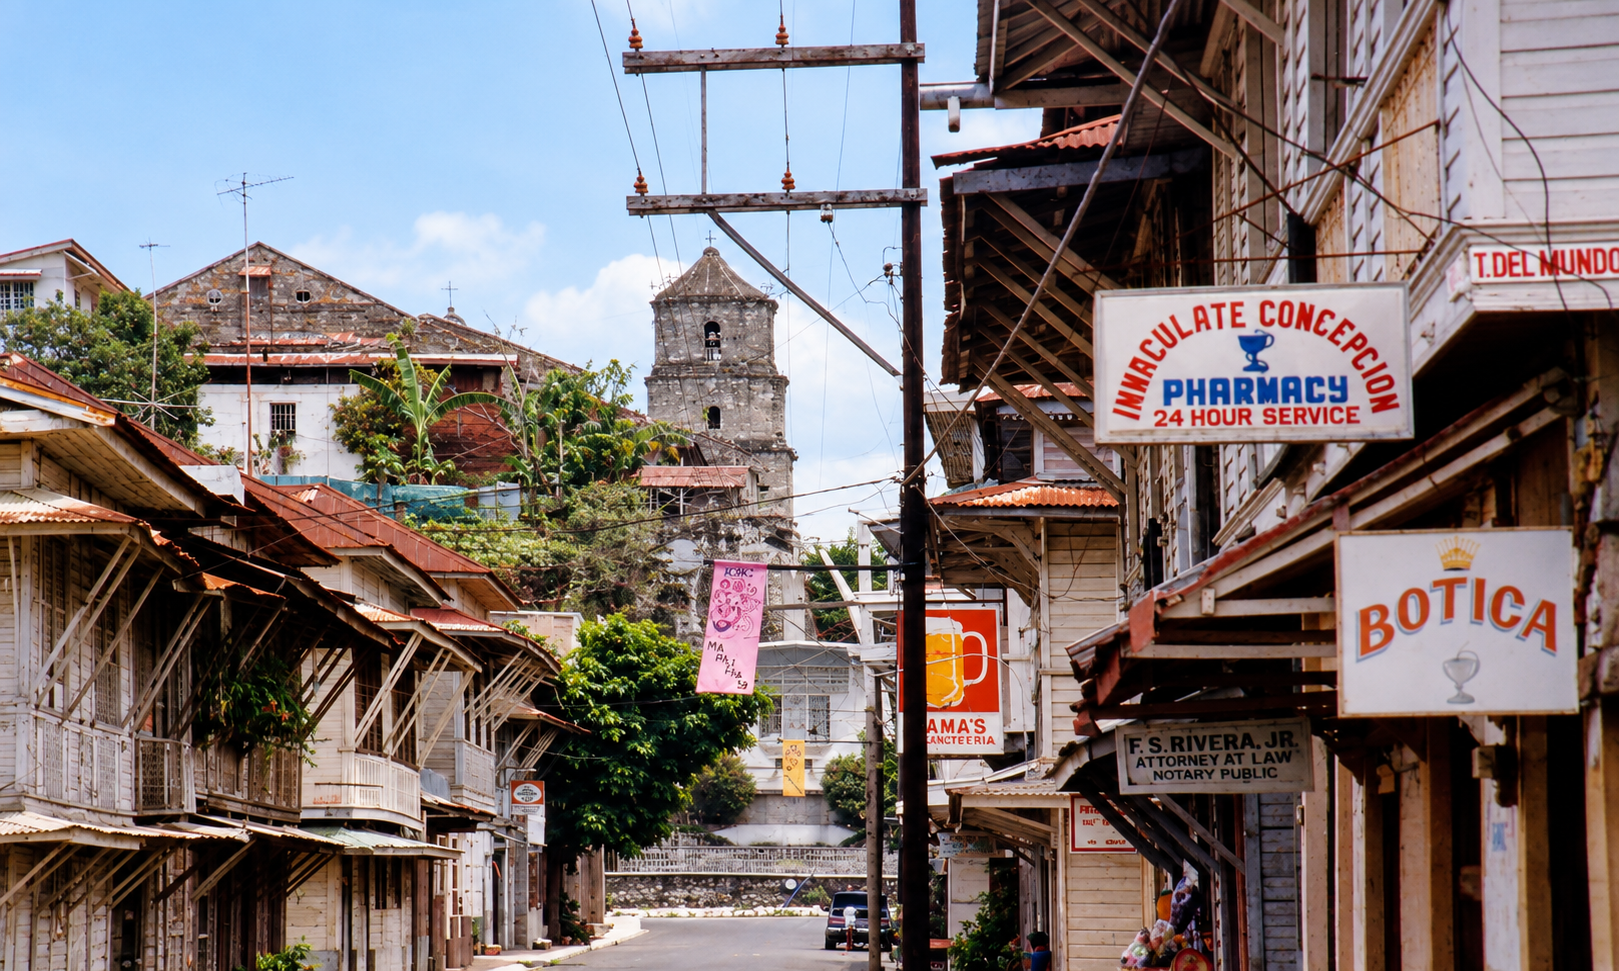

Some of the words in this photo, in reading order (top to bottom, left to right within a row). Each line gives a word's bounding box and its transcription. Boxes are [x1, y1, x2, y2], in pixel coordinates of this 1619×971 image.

[1539, 246, 1619, 277] MUNDO
[1259, 300, 1401, 414] CONCEPCION
[1162, 375, 1348, 407] PHARMACY
[1153, 408, 1185, 427] 24
[1190, 407, 1253, 427] HOUR
[1262, 405, 1361, 426] SERVICE
[1355, 576, 1559, 663] BOTICA
[927, 717, 987, 735] AMA'S
[927, 735, 996, 746] ANCTEERIA
[1136, 754, 1220, 769] ATTORNEY
[1224, 752, 1246, 766] AT
[1251, 750, 1293, 765] LAW
[1153, 768, 1215, 781] NOTARY
[1220, 766, 1279, 780] PUBLIC
